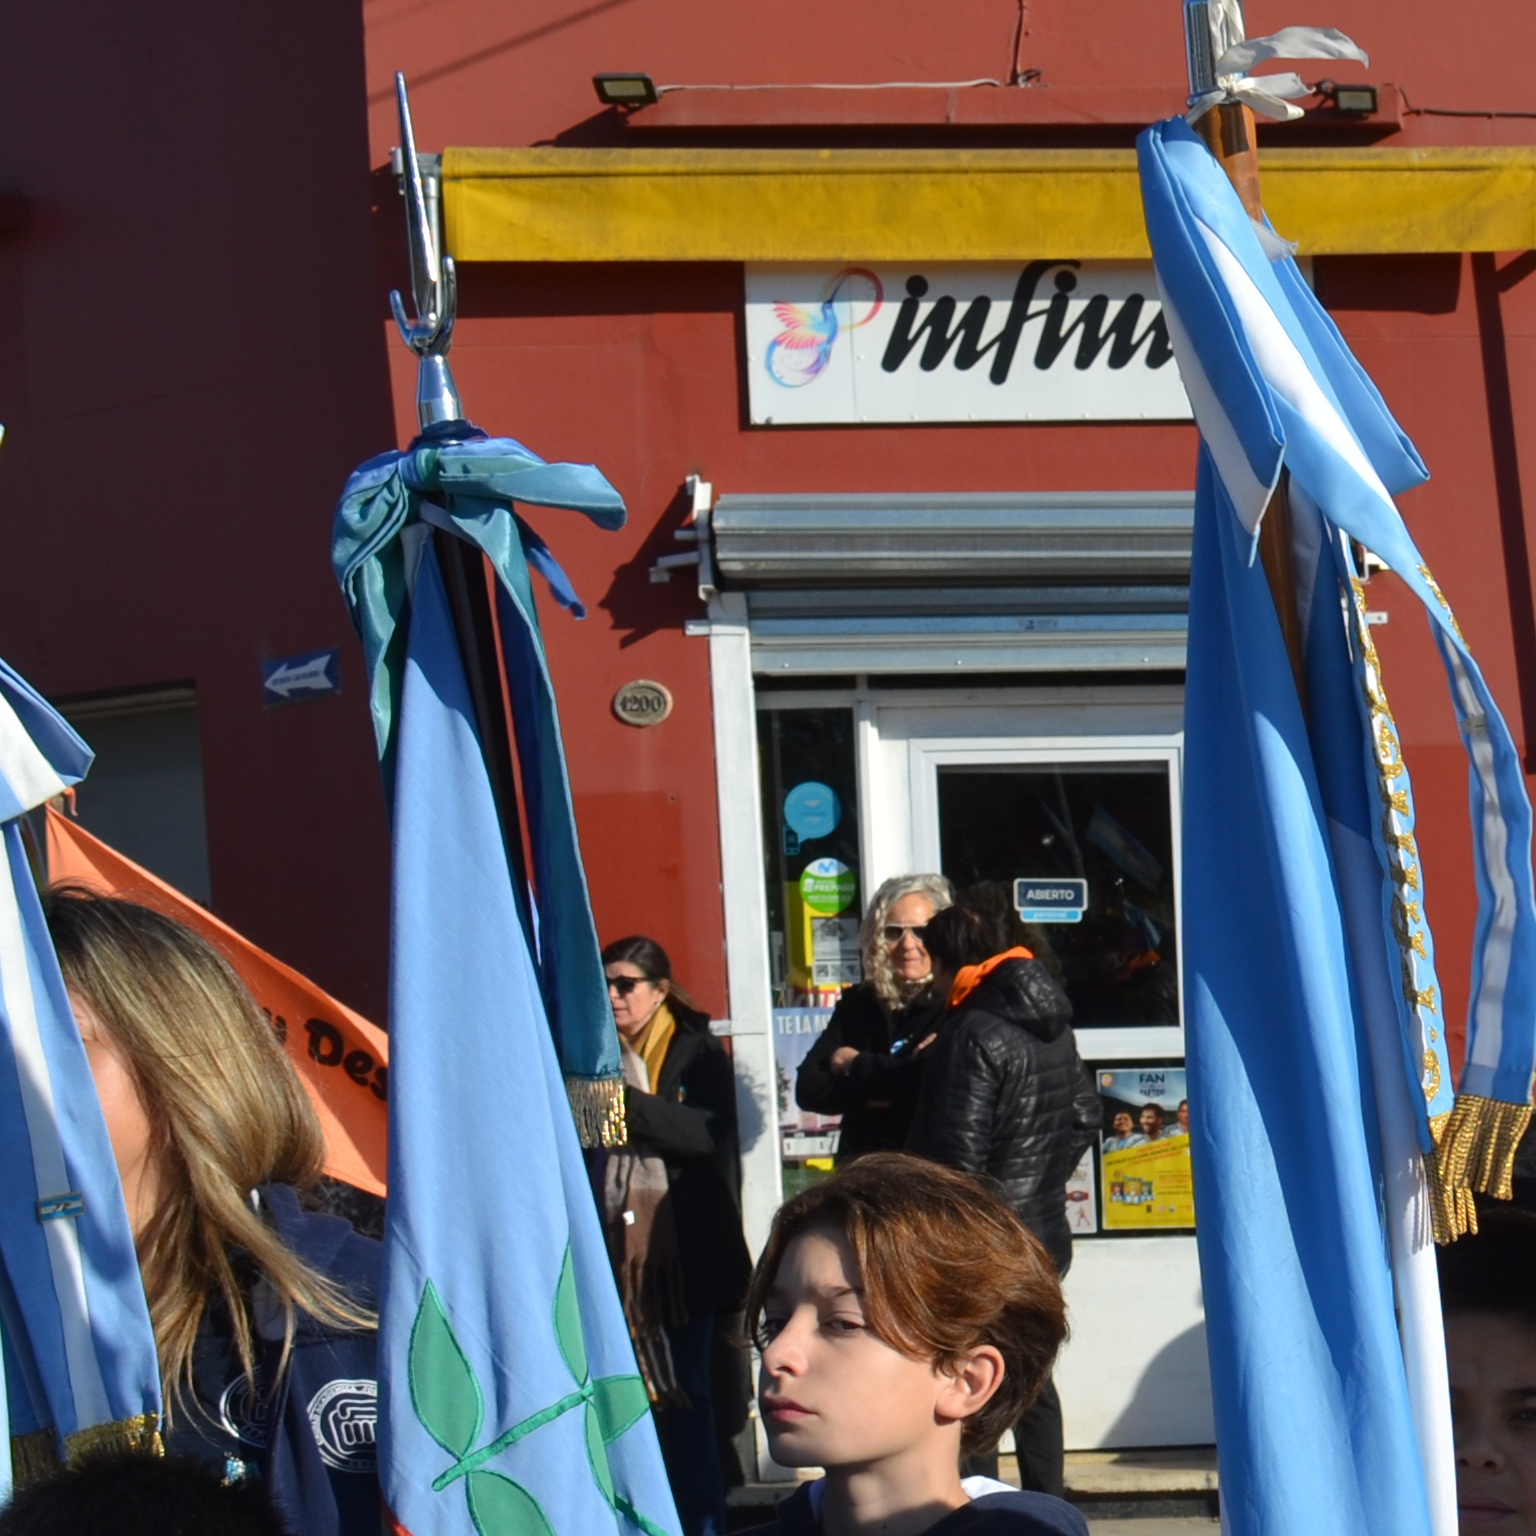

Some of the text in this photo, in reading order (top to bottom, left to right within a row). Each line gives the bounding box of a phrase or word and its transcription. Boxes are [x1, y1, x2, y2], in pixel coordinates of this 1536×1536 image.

[1026, 888, 1075, 901] ABIERTO
[776, 1014, 792, 1035] TE
[795, 1014, 812, 1035] LA
[1139, 1073, 1165, 1084] FAN
